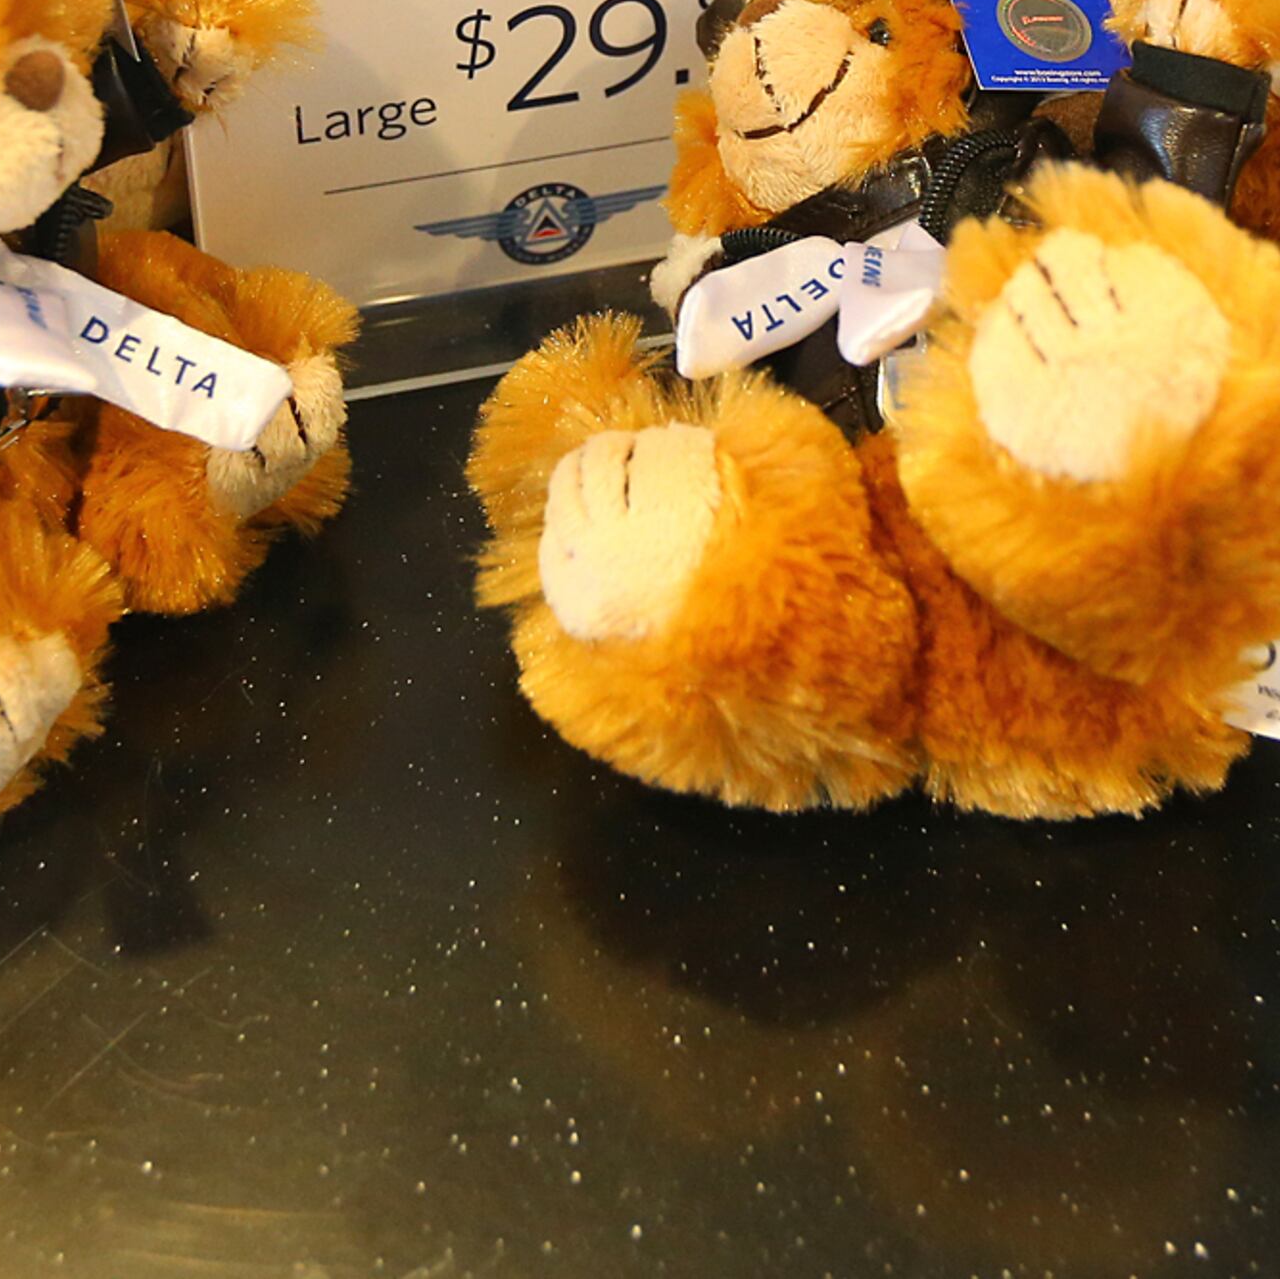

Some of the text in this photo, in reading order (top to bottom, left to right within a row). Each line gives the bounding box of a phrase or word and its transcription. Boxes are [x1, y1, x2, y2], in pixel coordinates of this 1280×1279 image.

[293, 96, 438, 145] Large
[513, 185, 576, 209] DELTA
[79, 315, 219, 400] DELTA
